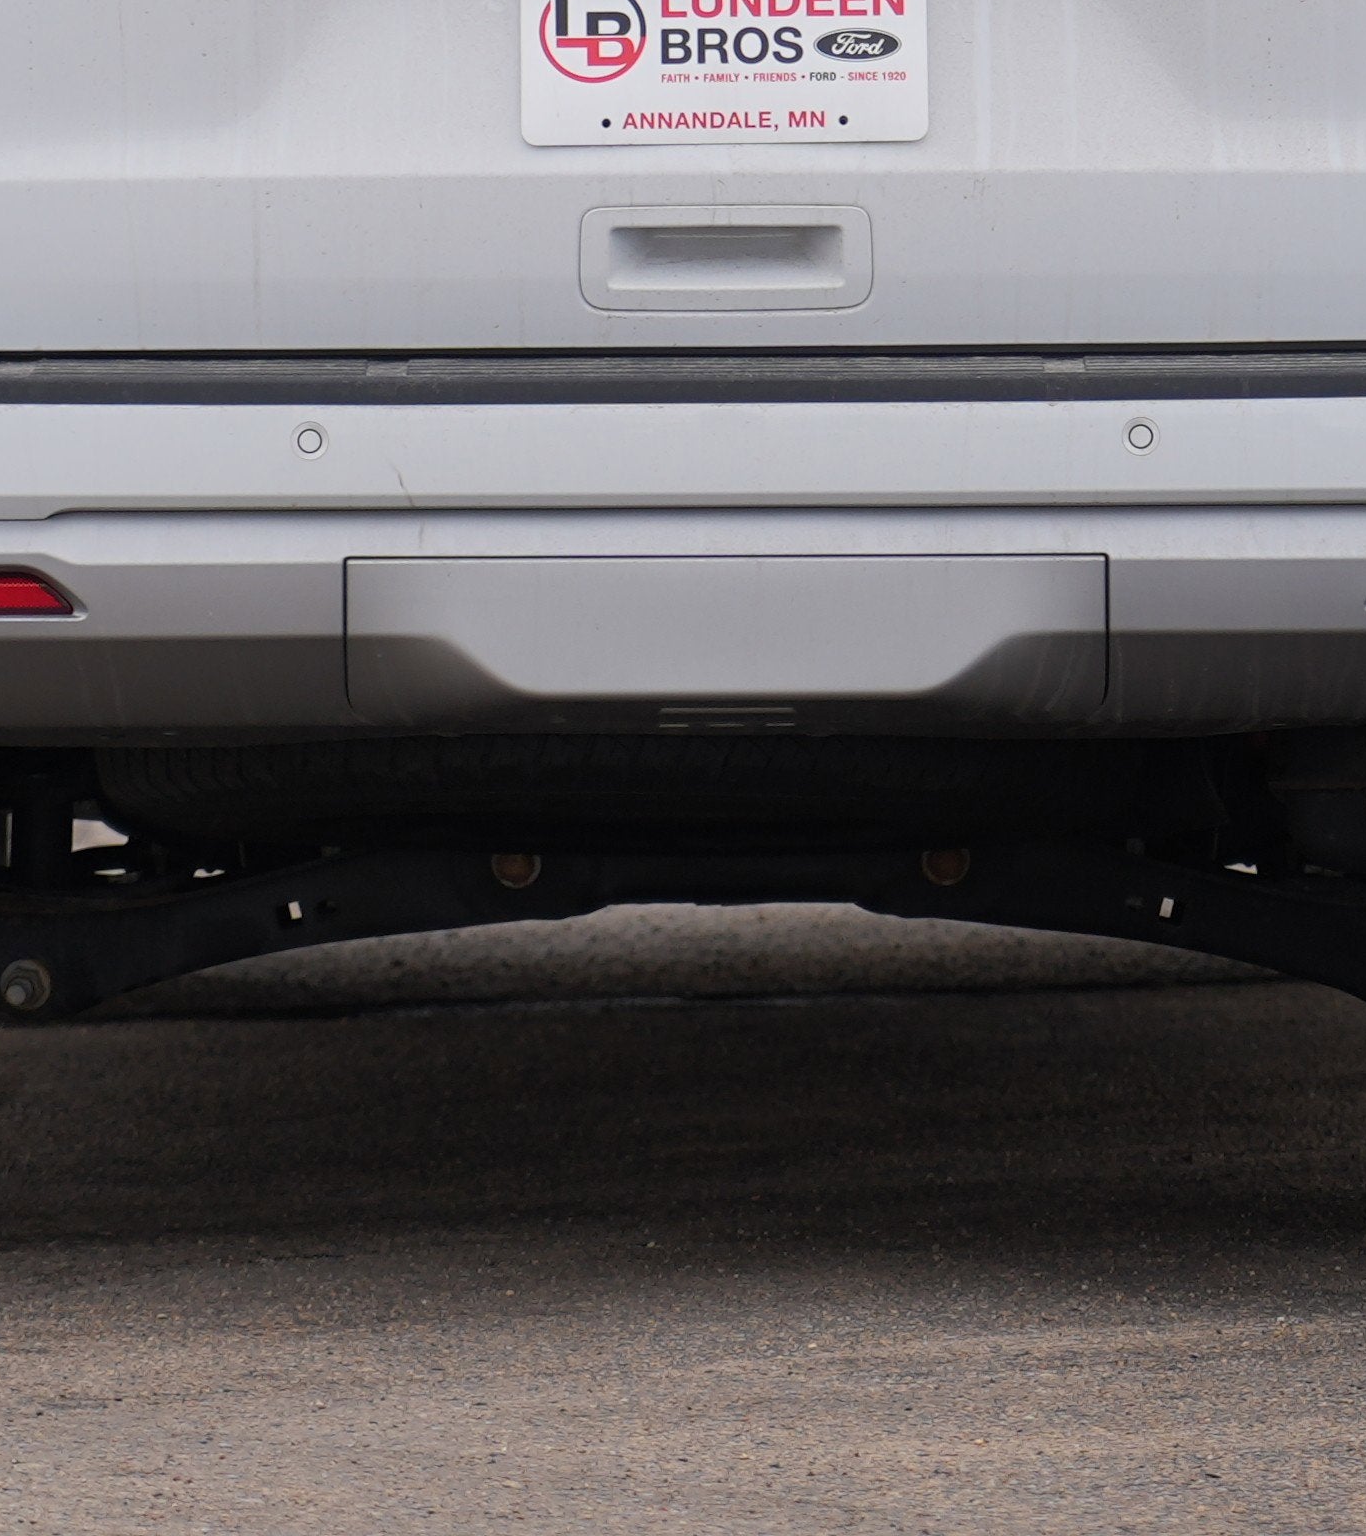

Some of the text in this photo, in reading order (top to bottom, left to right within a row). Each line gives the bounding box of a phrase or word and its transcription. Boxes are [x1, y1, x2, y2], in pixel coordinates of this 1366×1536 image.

[660, 26, 804, 65] BROS
[661, 70, 907, 84] FAITH FAMILY FRIENDS FORD SINCE 1920
[622, 110, 826, 132] ANNANDALE, MN
